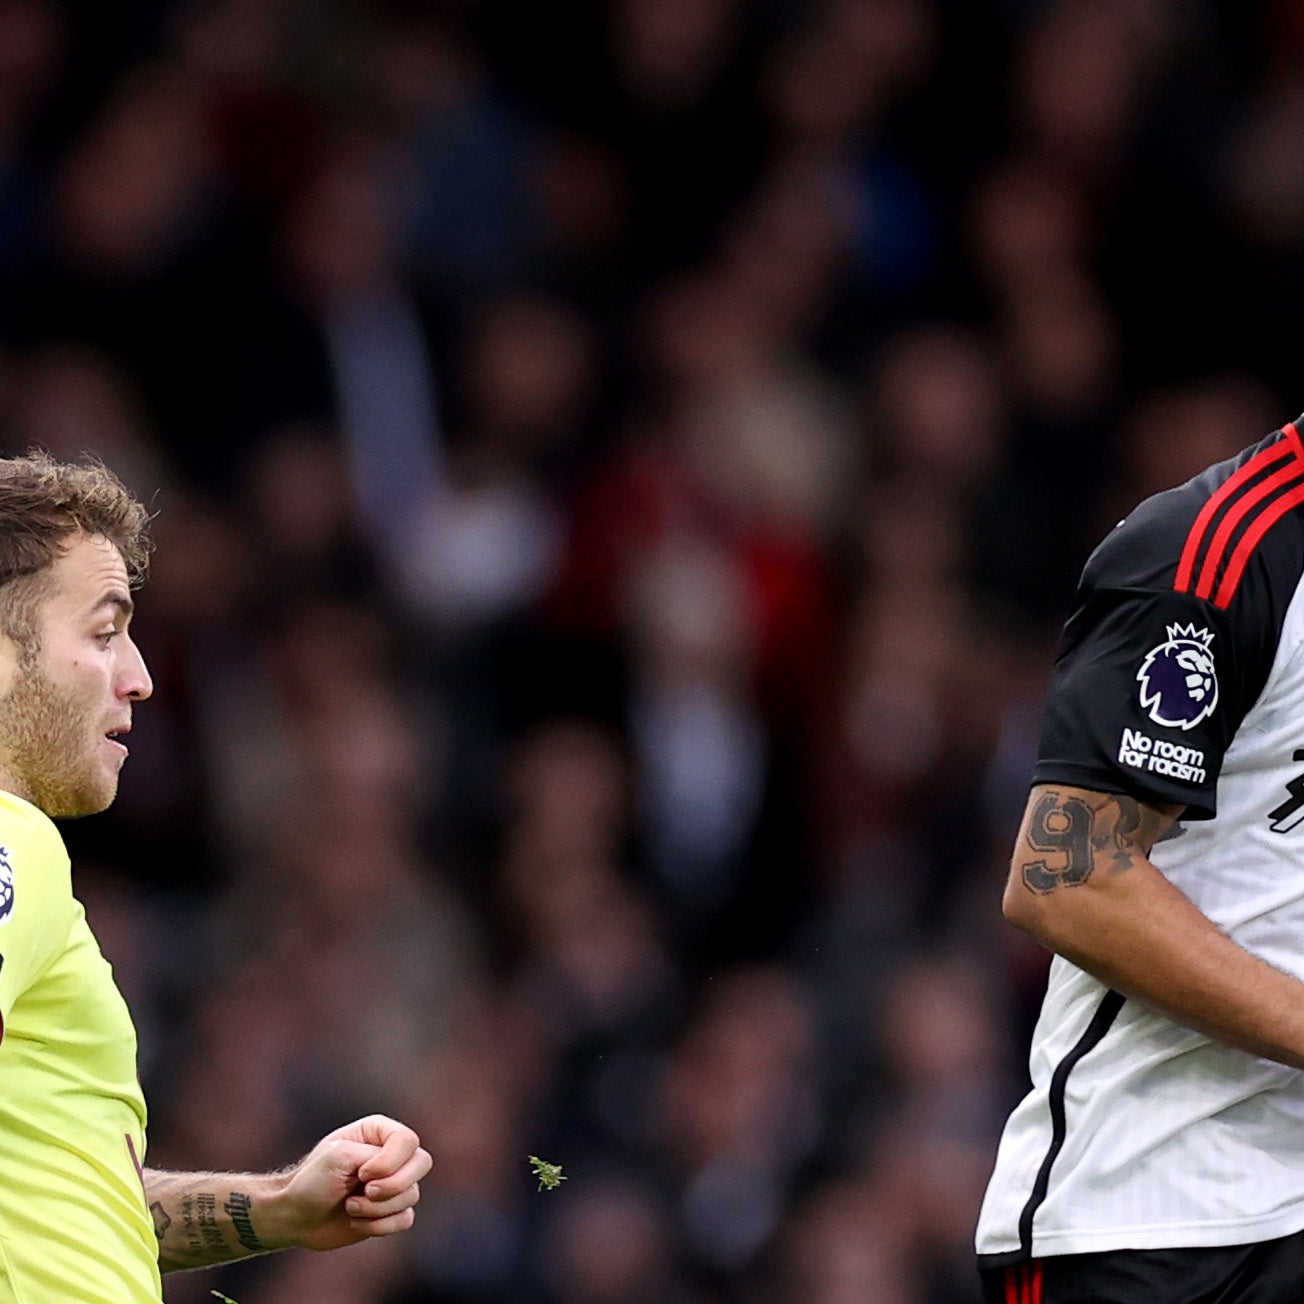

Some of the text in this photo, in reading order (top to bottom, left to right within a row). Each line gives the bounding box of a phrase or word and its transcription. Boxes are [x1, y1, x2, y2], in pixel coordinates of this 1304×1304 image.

[1118, 745, 1206, 783] for racism
[1121, 728, 1204, 766] No room
